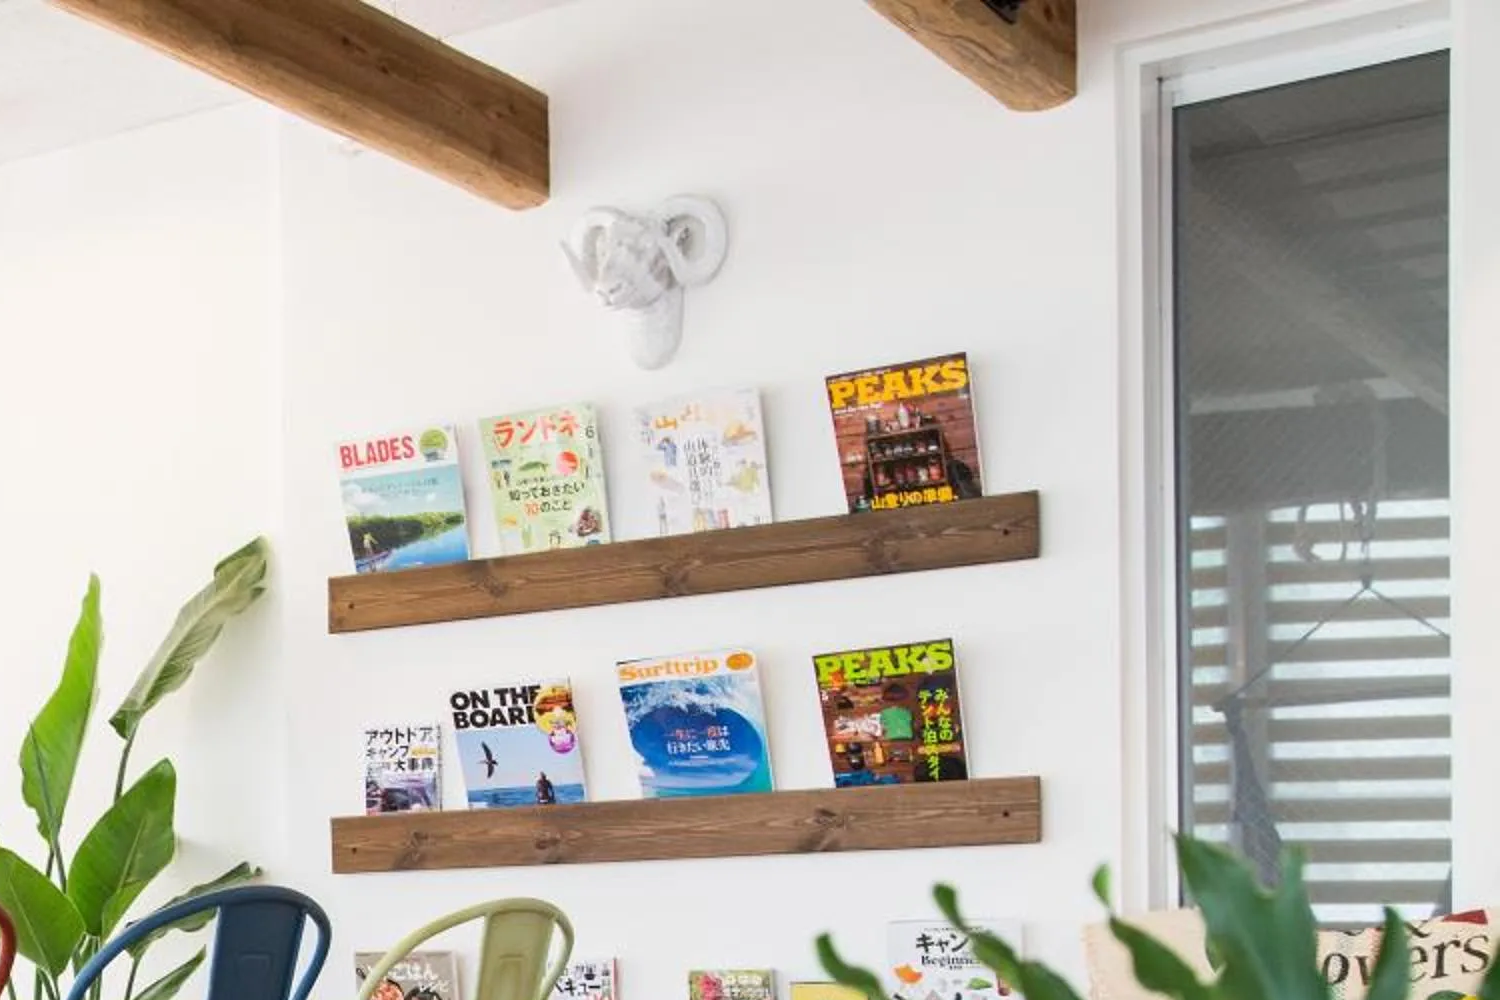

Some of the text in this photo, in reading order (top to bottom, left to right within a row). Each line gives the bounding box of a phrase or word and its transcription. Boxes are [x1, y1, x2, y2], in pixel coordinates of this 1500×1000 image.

[828, 358, 969, 409] PEAKS
[340, 435, 417, 470] BLADES
[618, 658, 721, 681] Surftrip
[815, 643, 953, 687] PEAKS
[450, 690, 490, 711] ON
[364, 725, 434, 746] アウトドア
[916, 932, 970, 953] キャン
[921, 955, 981, 970] Beginne
